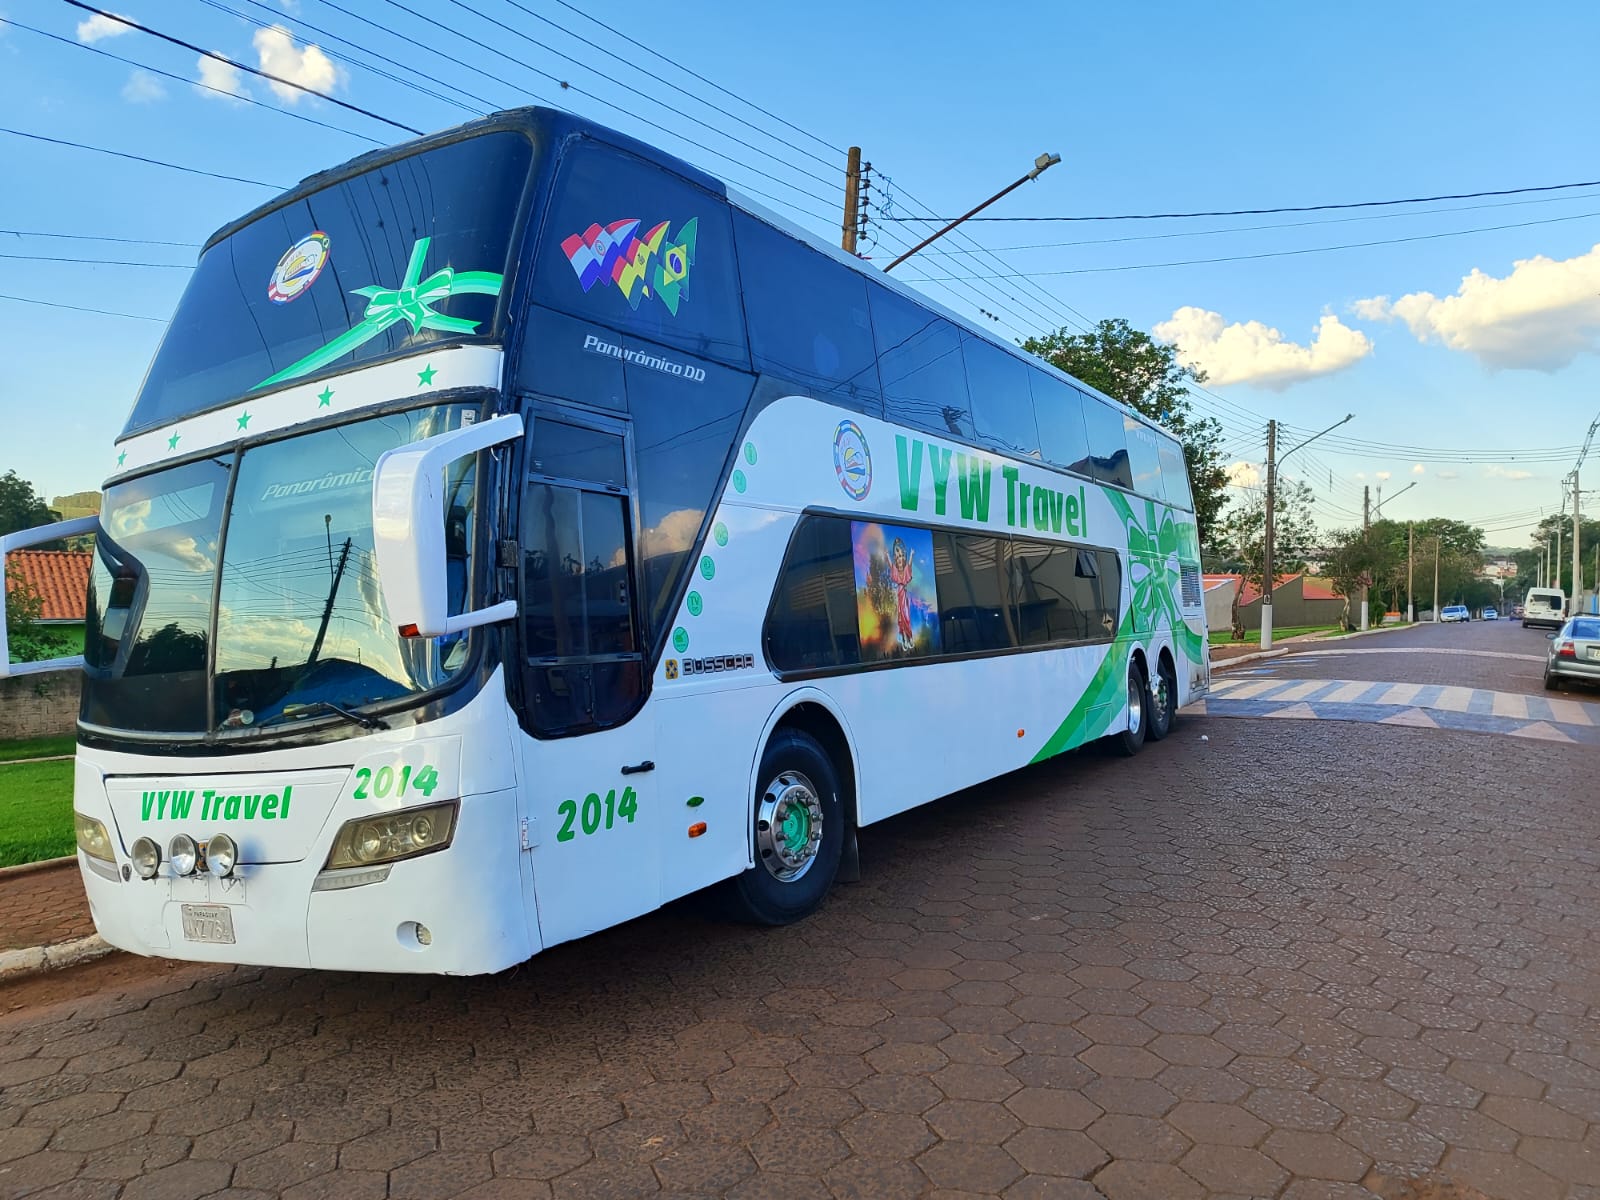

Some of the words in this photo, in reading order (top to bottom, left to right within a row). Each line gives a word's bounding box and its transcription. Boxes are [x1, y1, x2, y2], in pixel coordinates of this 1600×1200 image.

[583, 334, 682, 375] Panorâmico
[683, 364, 706, 382] DD
[894, 433, 992, 523] VYW
[1001, 464, 1088, 538] Travel
[682, 653, 754, 676] BUSSCAR
[353, 764, 439, 800] 2014
[141, 789, 195, 822] VYW
[200, 785, 293, 821] Travel
[556, 786, 638, 843] 2014
